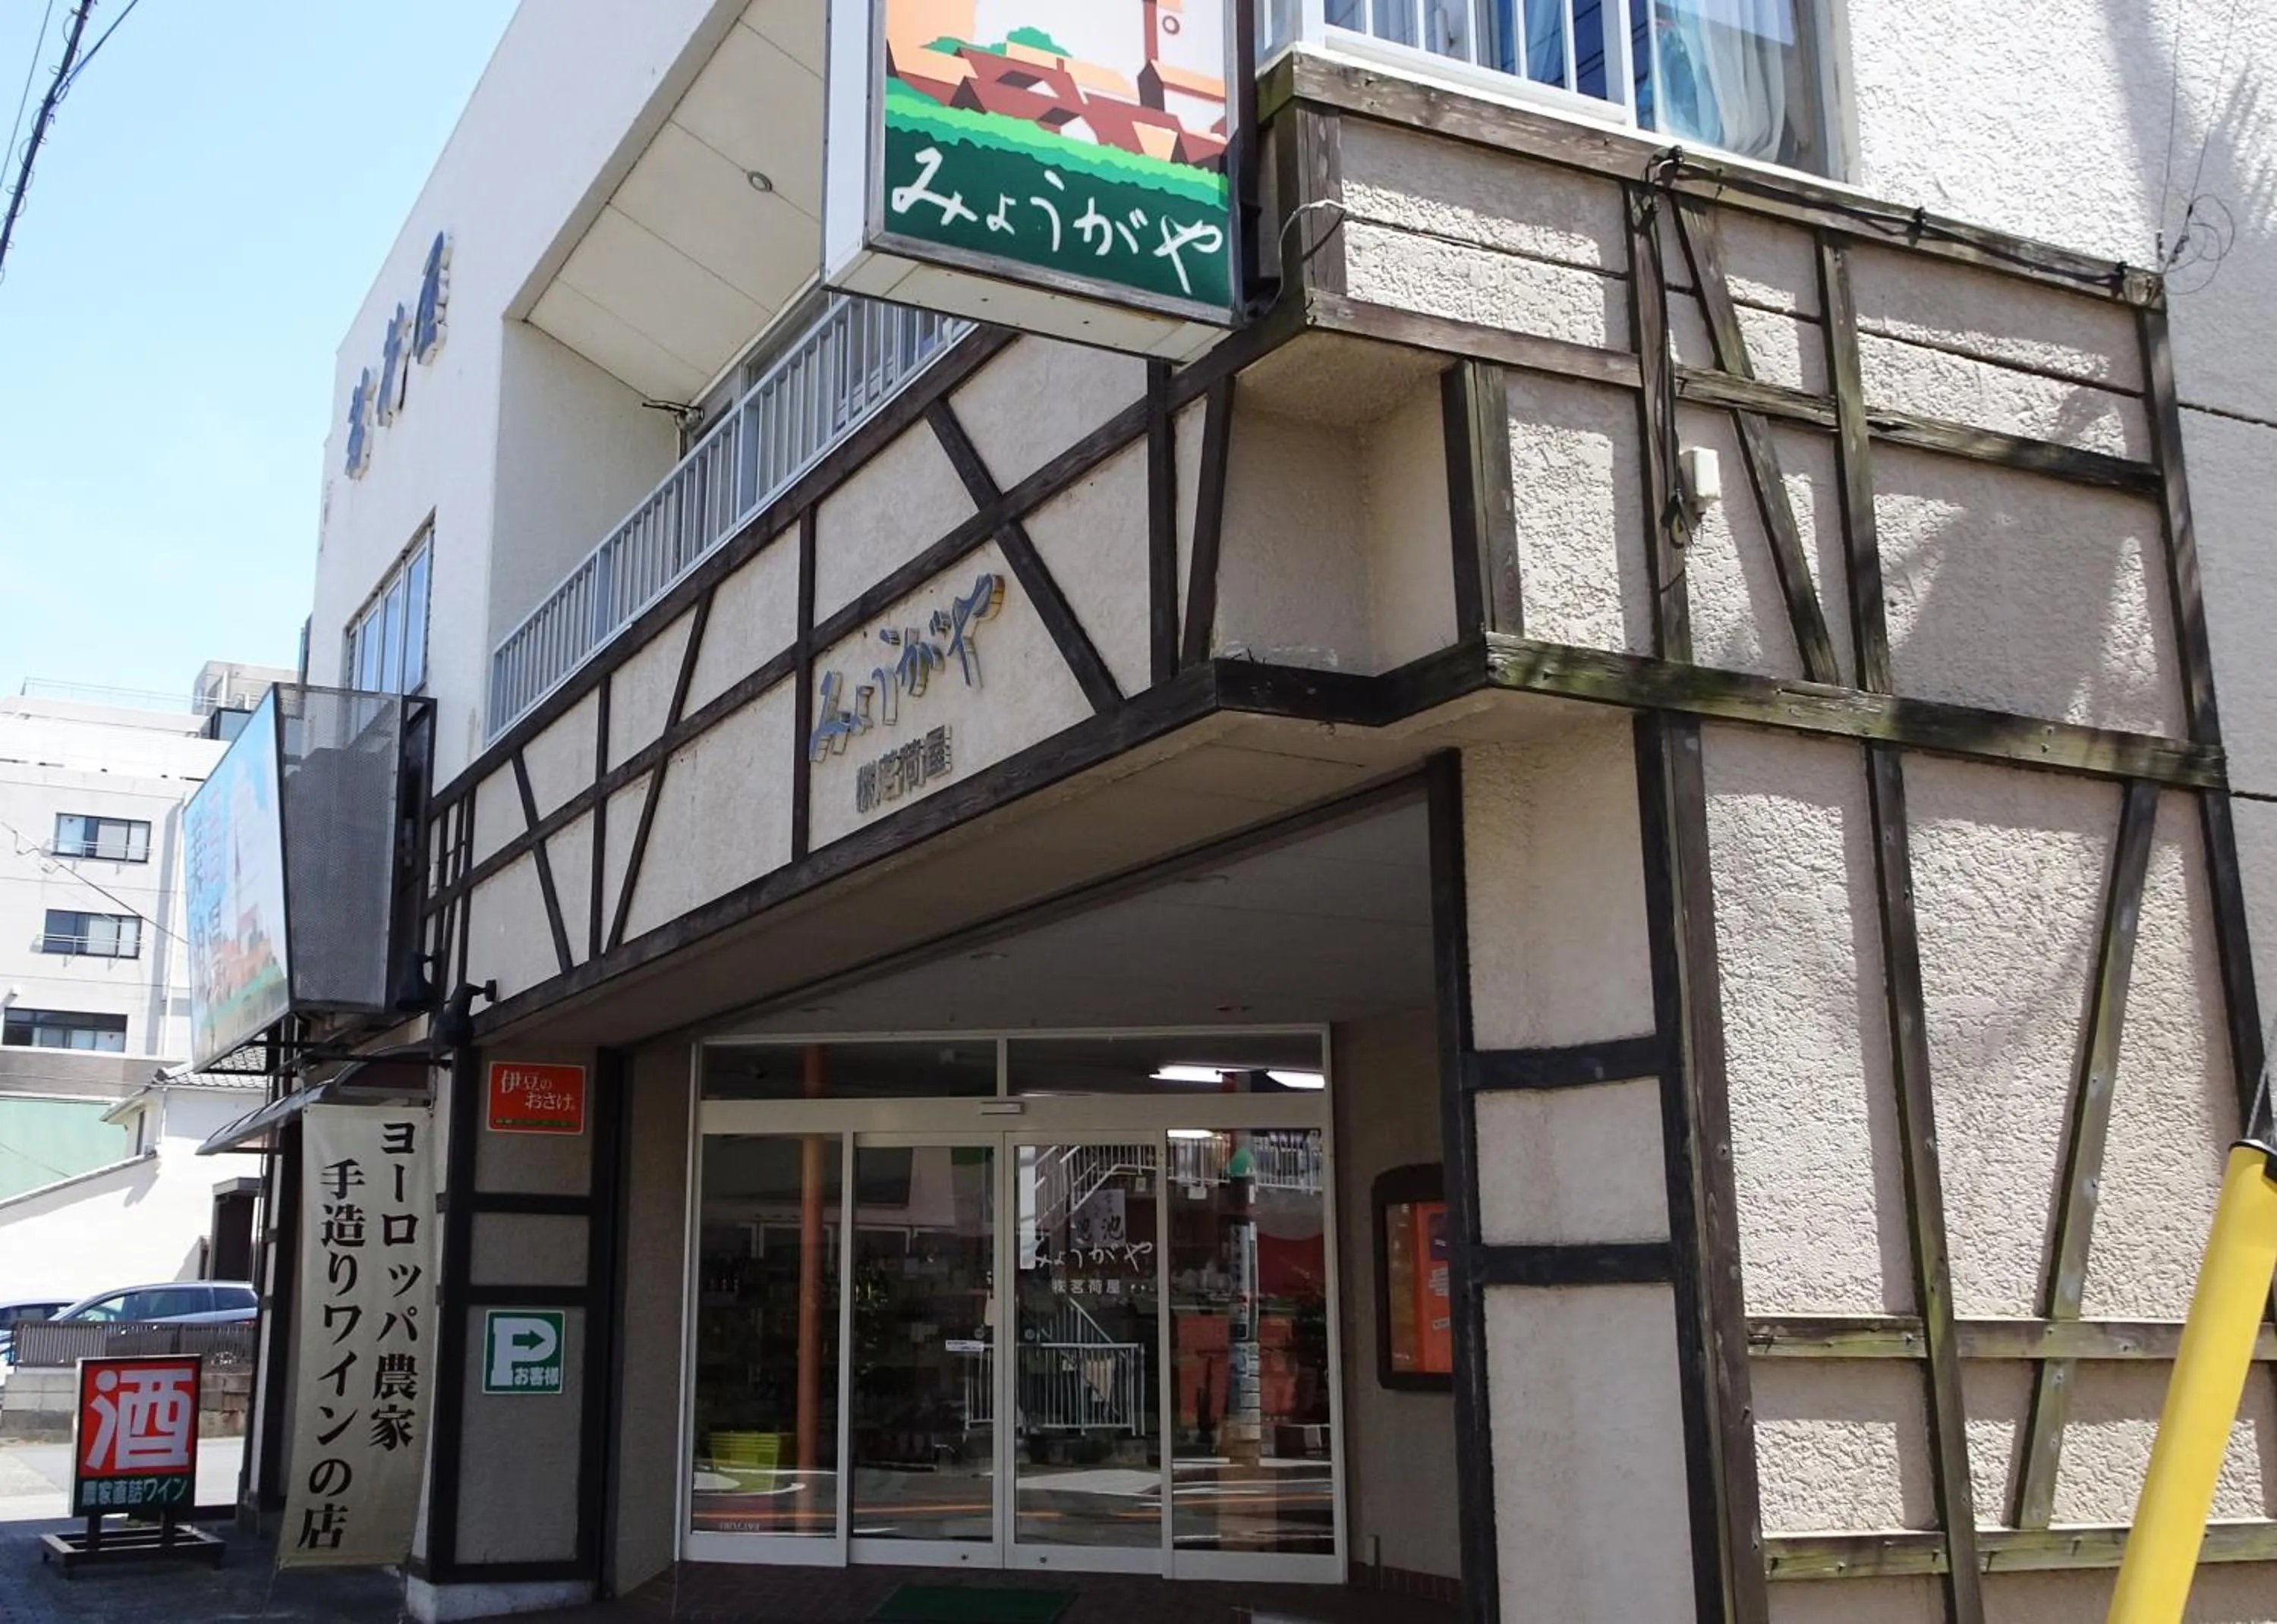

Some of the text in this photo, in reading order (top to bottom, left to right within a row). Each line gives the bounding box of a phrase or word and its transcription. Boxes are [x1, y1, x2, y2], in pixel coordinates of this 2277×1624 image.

[892, 147, 1224, 294] みょうがや
[810, 573, 1005, 763] みょうがや
[501, 1069, 553, 1094] 伊豆の
[298, 1158, 365, 1550] 手造りワインの店
[369, 1121, 422, 1450] ヨーロッパ農家
[86, 1368, 194, 1470] 酒
[514, 1367, 559, 1386] お客様
